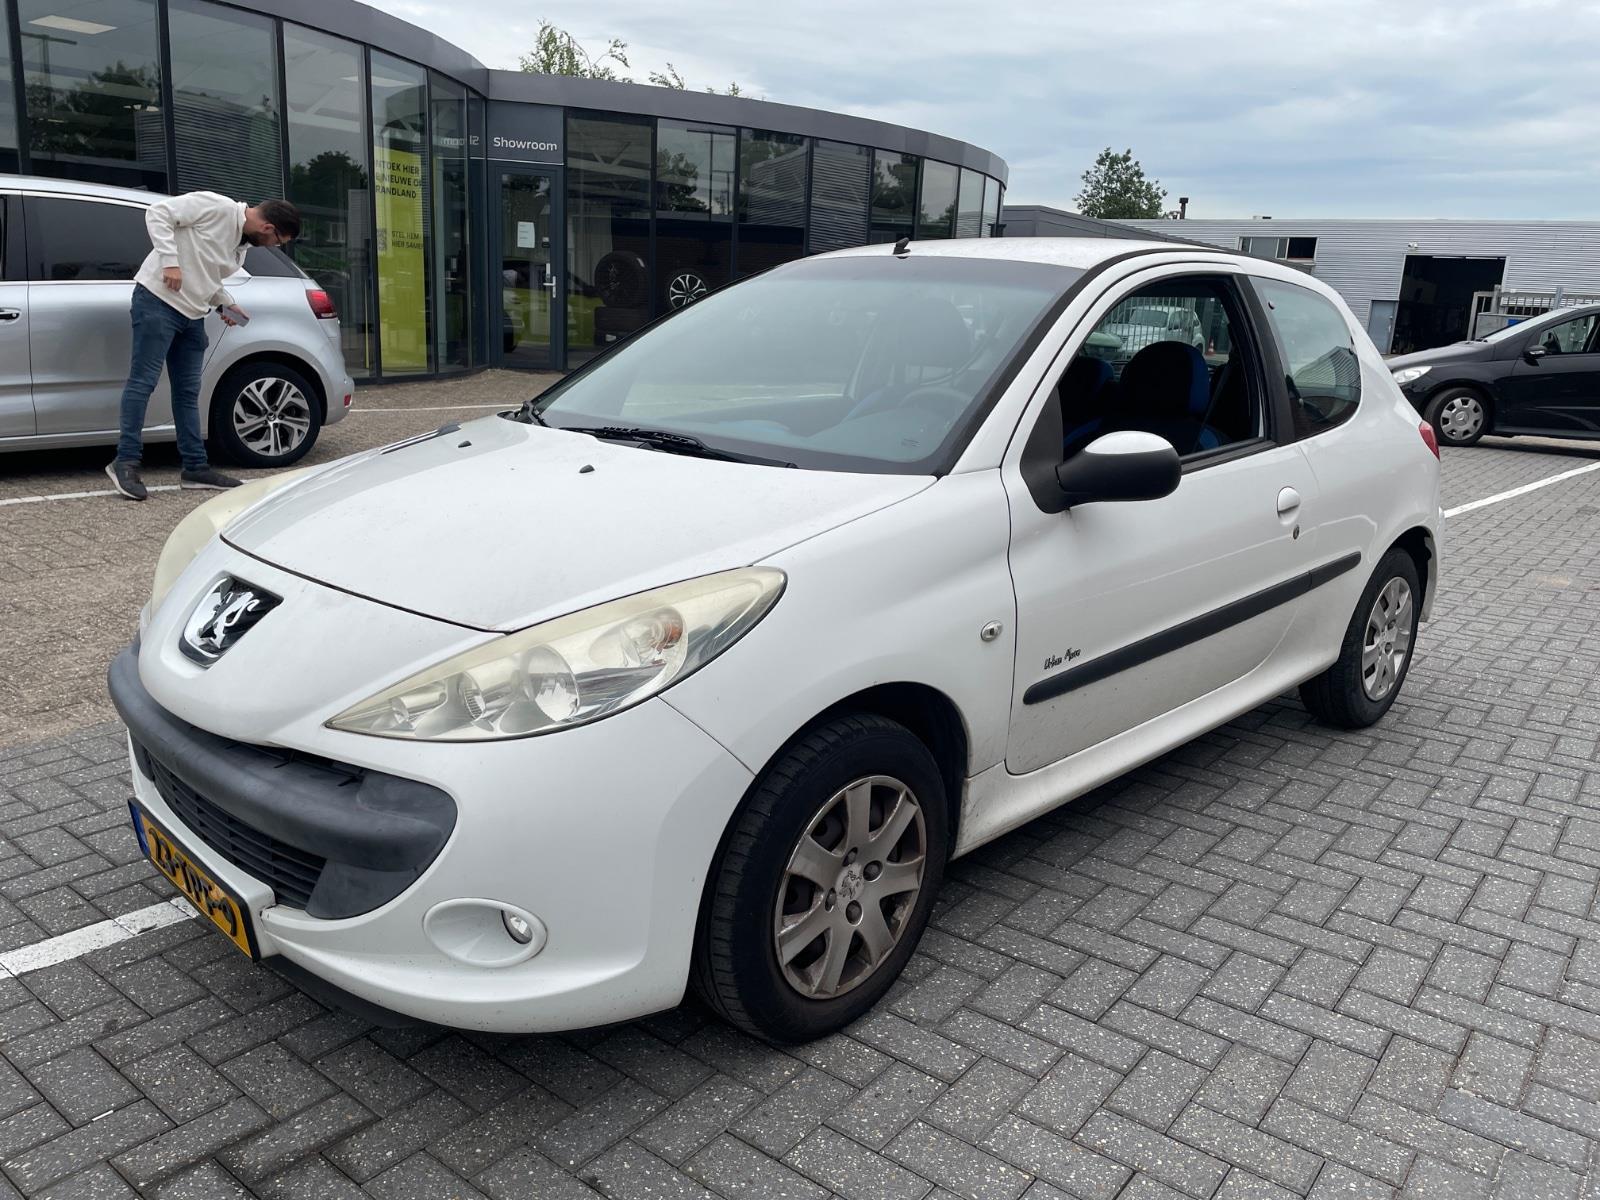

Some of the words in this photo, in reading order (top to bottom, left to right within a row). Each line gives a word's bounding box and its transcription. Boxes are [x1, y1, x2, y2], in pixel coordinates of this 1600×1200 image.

[493, 137, 557, 151] Showroom
[402, 164, 420, 175] HIER
[382, 173, 412, 186] NIEUWE
[1044, 655, 1062, 670] Urban
